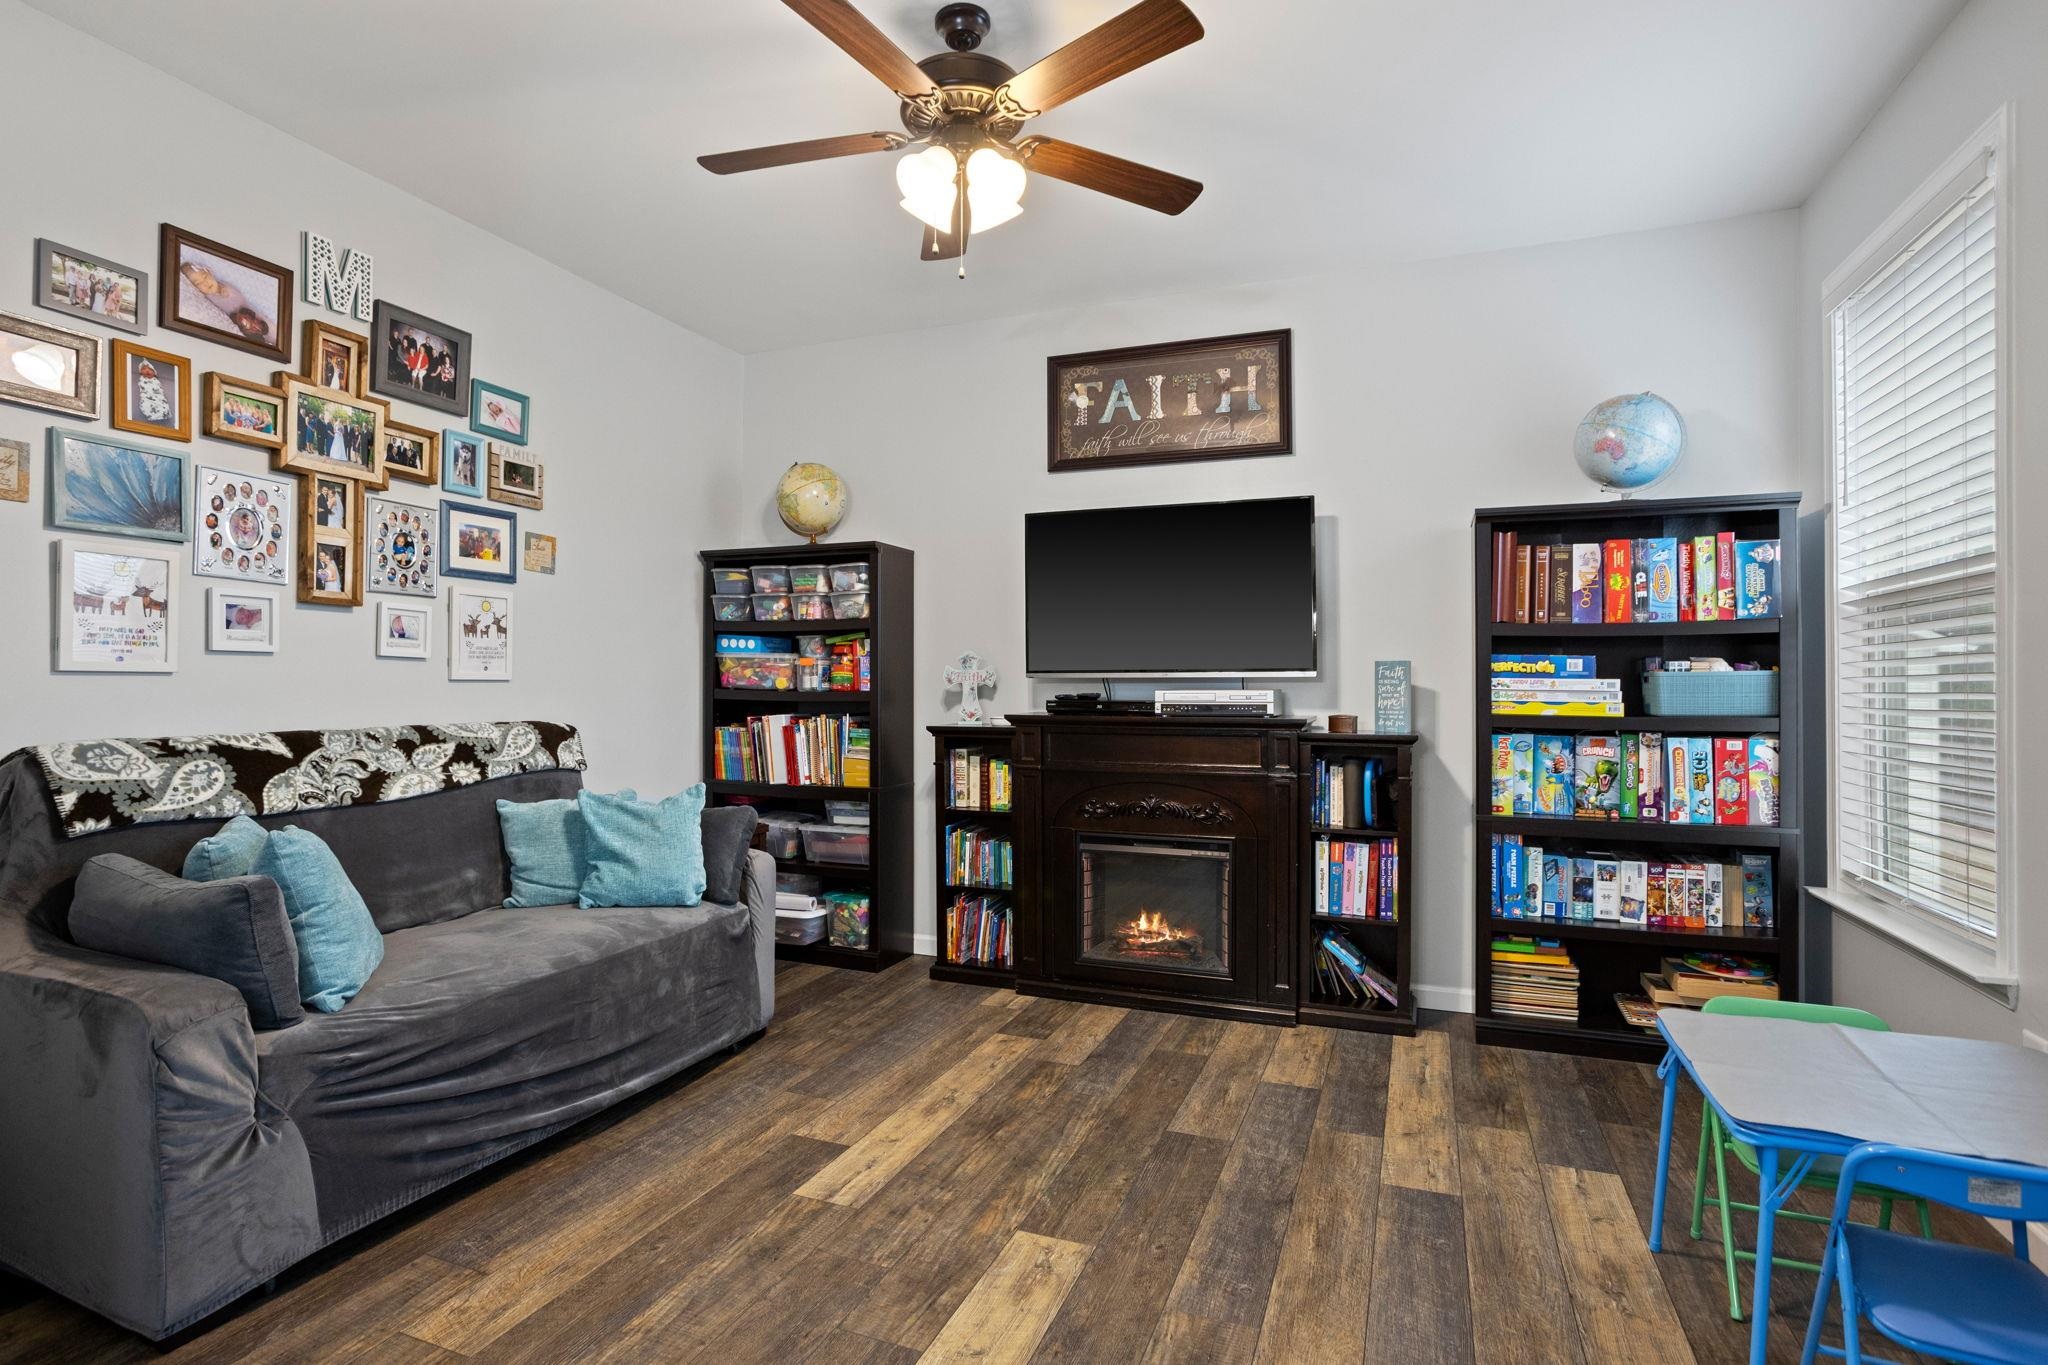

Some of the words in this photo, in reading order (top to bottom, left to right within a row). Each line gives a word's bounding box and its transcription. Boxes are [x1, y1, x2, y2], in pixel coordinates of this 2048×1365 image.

[303, 231, 373, 322] M
[1072, 364, 1262, 426] FAITH
[1070, 424, 1128, 458] faith
[1118, 420, 1160, 447] will
[1149, 431, 1171, 445] see
[1174, 432, 1193, 443] us
[1195, 413, 1268, 449] through
[500, 445, 539, 463] FAMILY
[1681, 545, 1690, 568] Tiddly
[1682, 570, 1690, 594] Winks
[1582, 747, 1615, 757] CRUNCH
[1692, 751, 1708, 774] ICE
